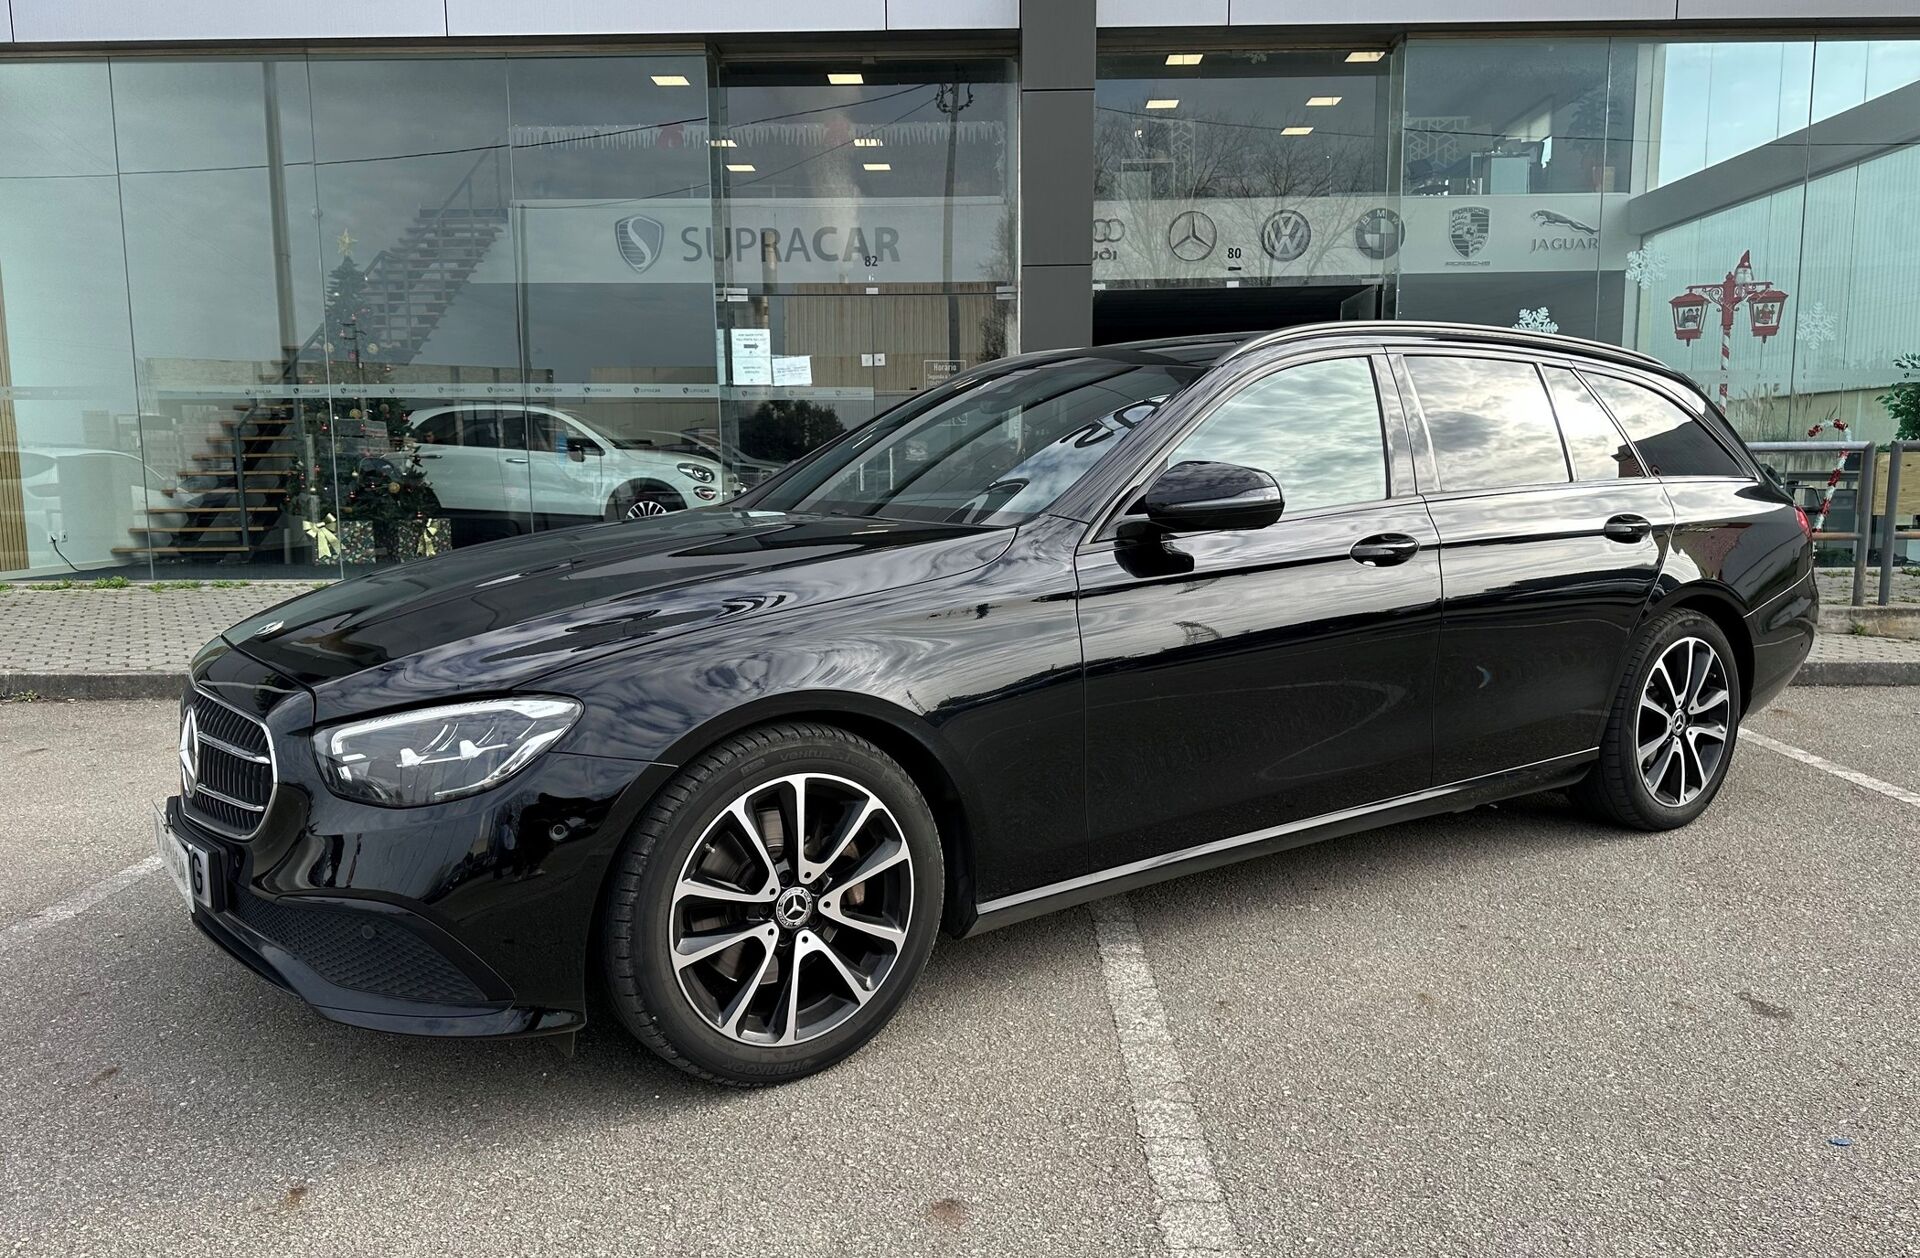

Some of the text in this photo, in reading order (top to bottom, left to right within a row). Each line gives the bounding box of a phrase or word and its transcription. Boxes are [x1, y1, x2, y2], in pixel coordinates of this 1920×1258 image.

[681, 226, 901, 262] SUPRACAR
[1529, 237, 1599, 253] JAGUAR
[1091, 248, 1118, 261] udi
[1227, 247, 1242, 259] 80
[864, 255, 879, 267] 82
